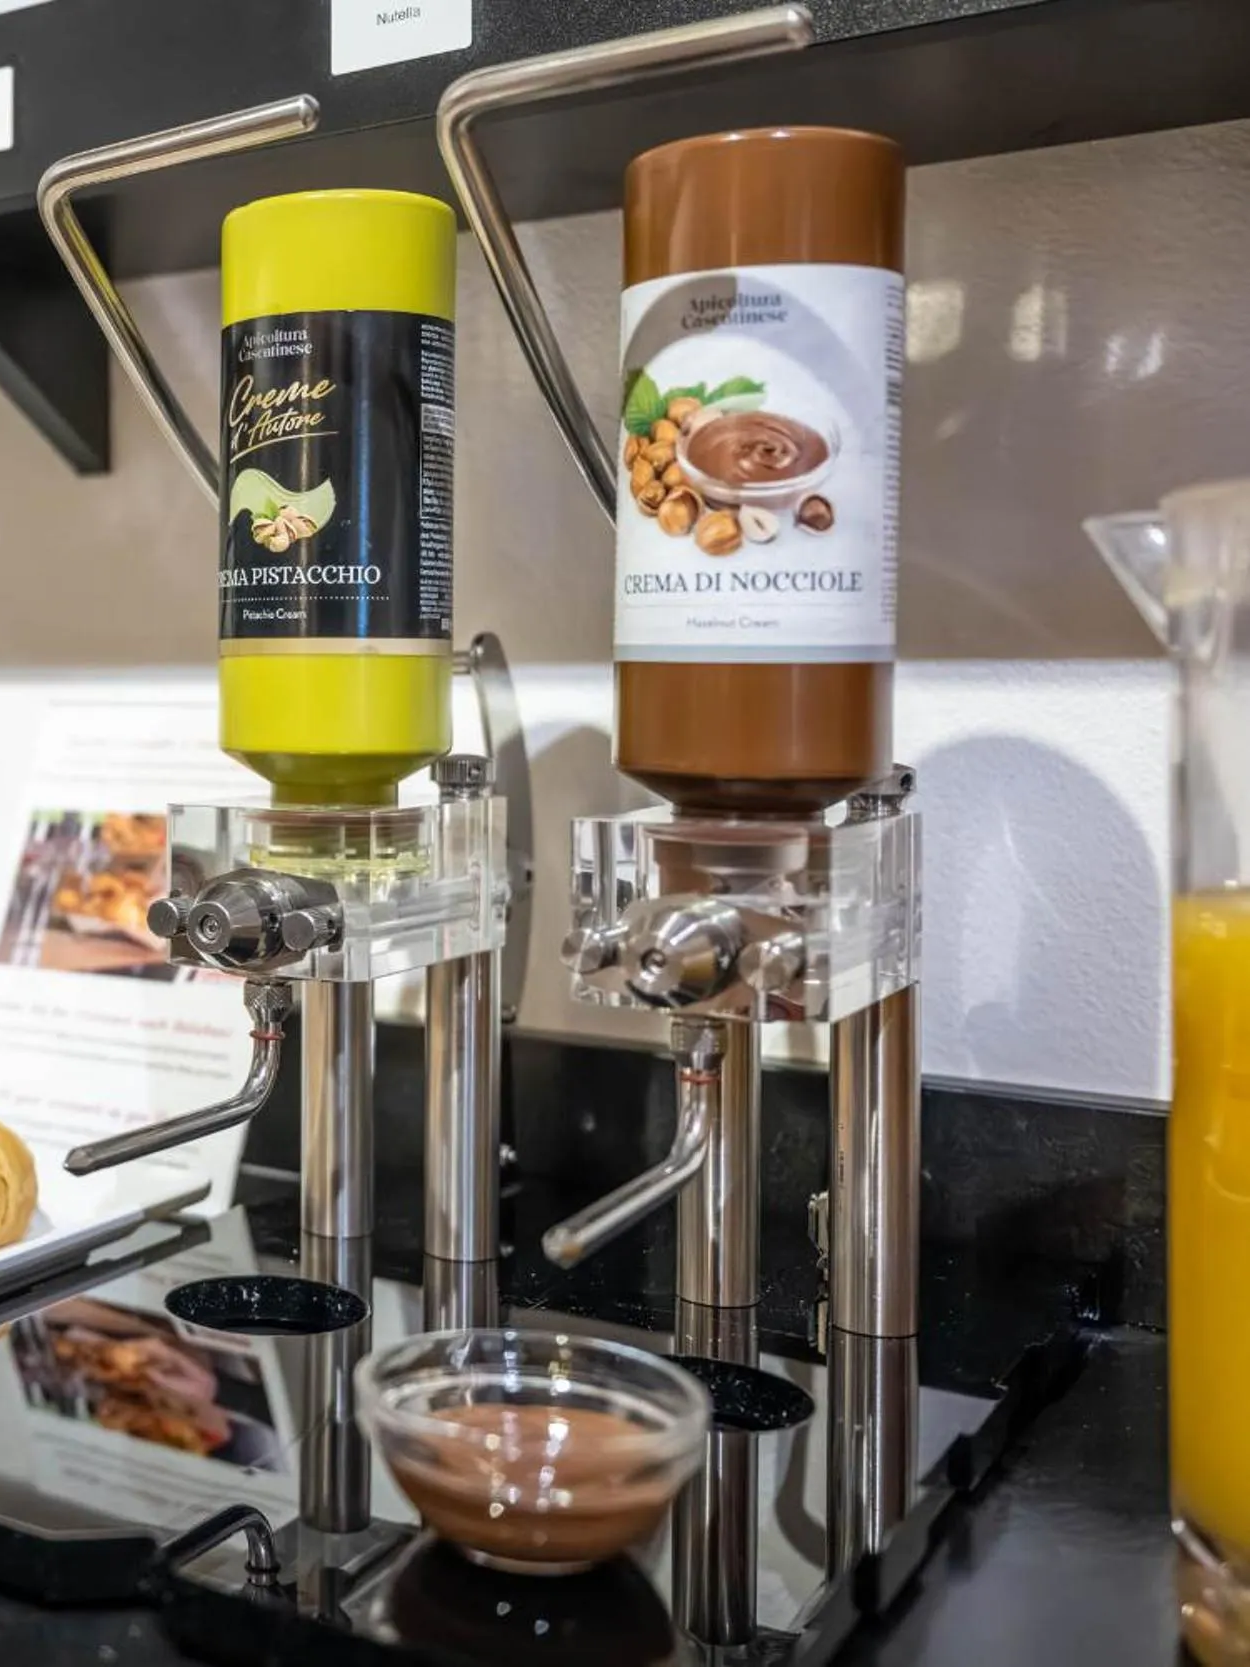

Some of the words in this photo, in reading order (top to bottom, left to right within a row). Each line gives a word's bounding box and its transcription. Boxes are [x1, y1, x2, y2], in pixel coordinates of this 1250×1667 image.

[376, 6, 421, 26] Nutella
[229, 374, 337, 428] Creme
[218, 567, 249, 588] EMA
[251, 564, 382, 586] PISTACCHIO
[624, 572, 688, 594] CREMA
[695, 571, 722, 592] DI
[730, 570, 863, 593] NOCCIOLE
[242, 608, 275, 620] Pistachio
[276, 607, 307, 620] Cream
[738, 616, 781, 629] Cream
